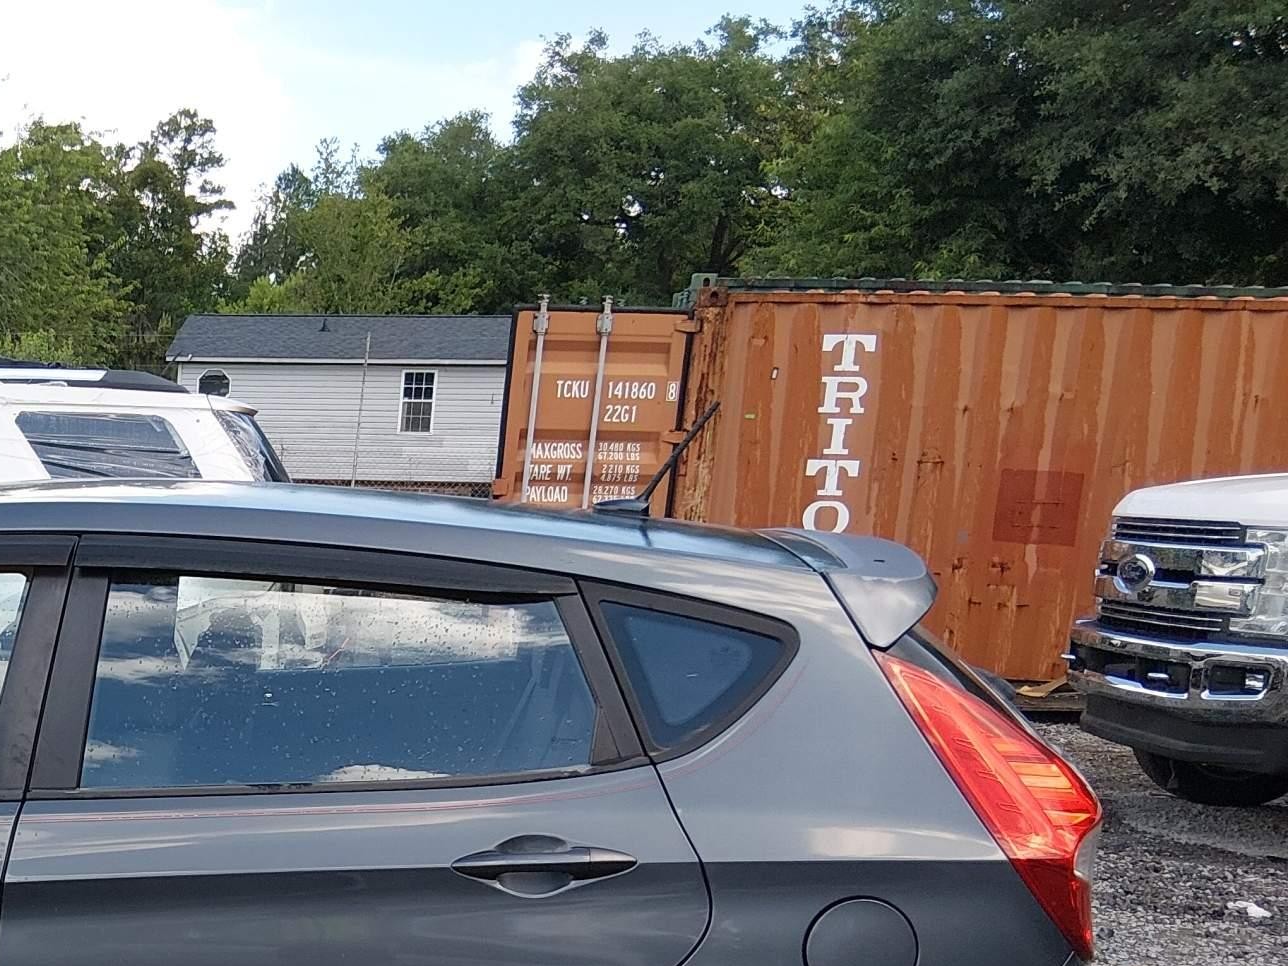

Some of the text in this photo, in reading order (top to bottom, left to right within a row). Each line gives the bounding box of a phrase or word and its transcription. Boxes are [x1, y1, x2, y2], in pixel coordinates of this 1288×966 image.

[556, 380, 677, 400] TCKU 141860 8
[603, 405, 637, 423] 22G1
[626, 443, 641, 452] KGS
[626, 452, 640, 460] LBS
[528, 464, 553, 480] TARE
[625, 465, 640, 474] KGS
[621, 486, 636, 495] KGS
